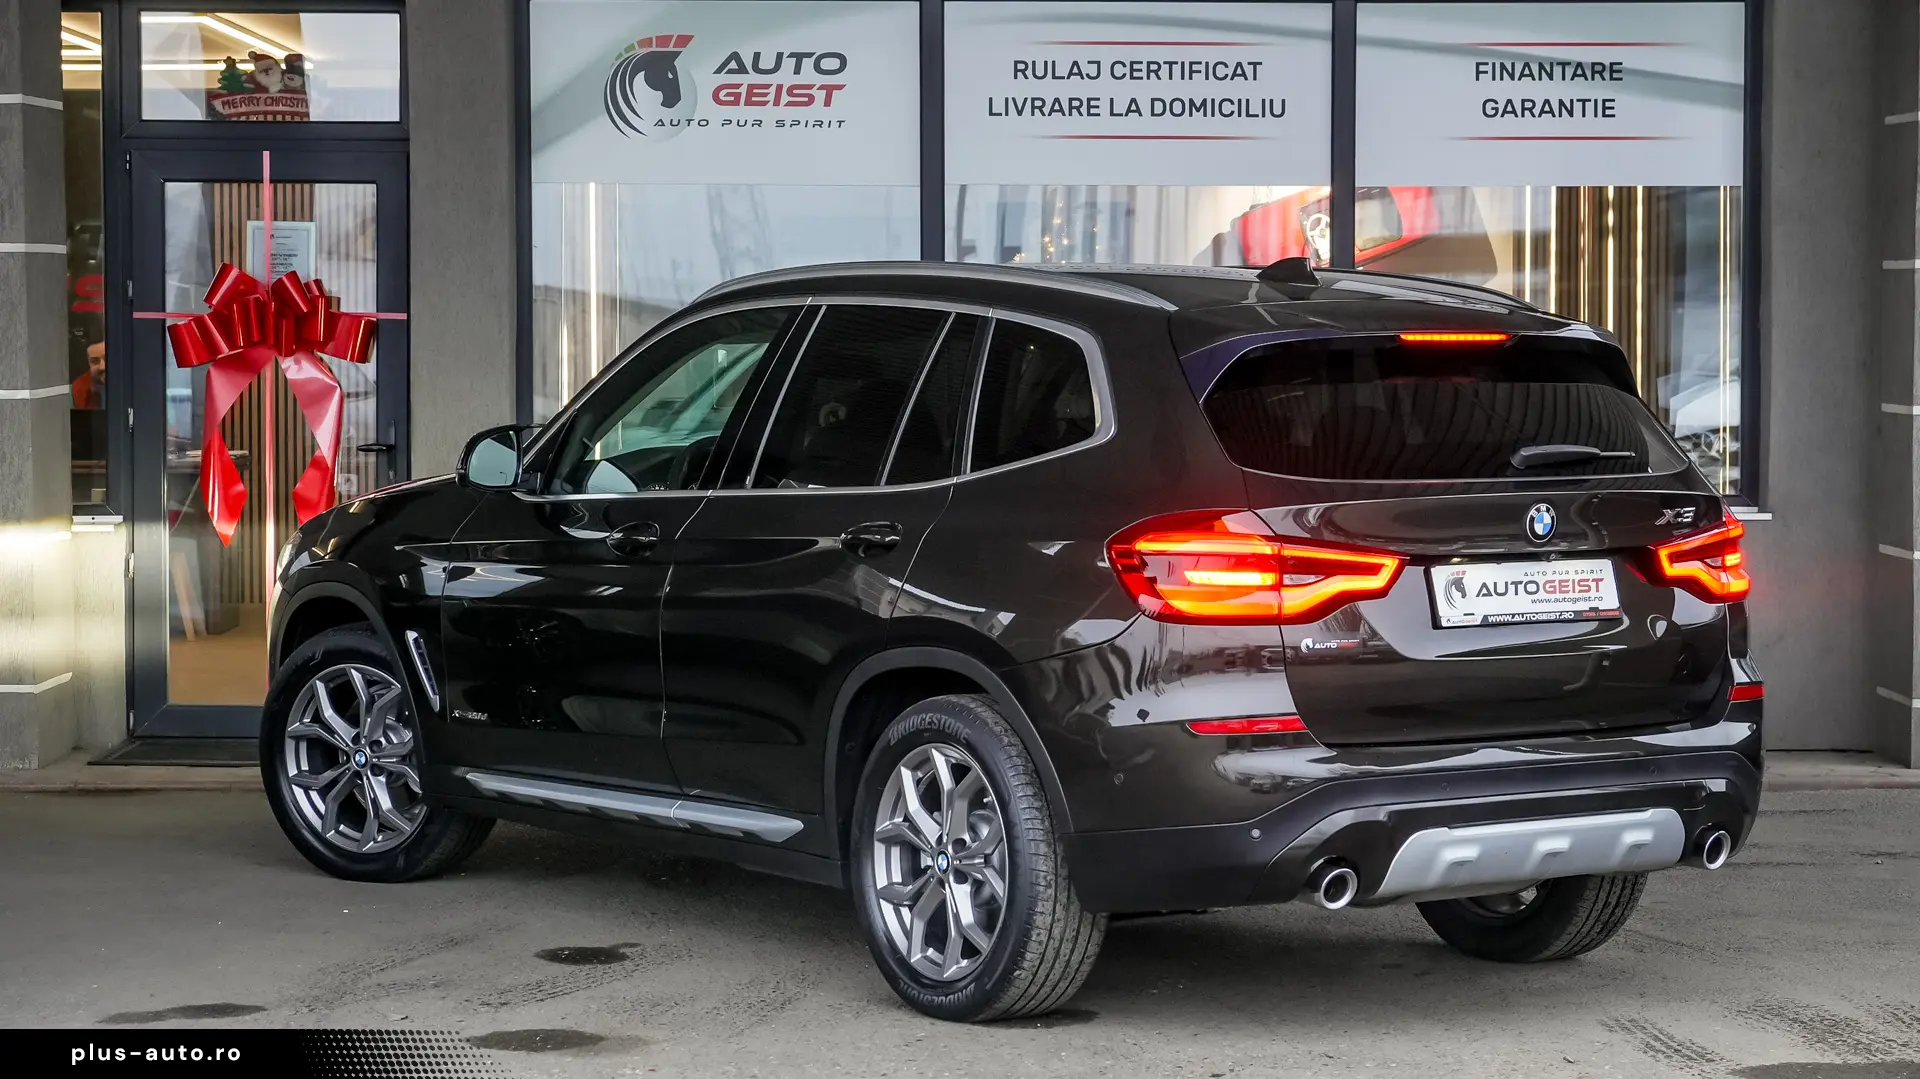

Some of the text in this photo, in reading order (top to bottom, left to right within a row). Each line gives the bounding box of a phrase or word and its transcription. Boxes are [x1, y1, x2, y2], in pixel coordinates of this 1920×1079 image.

[712, 51, 848, 75] AUTO
[1013, 60, 1263, 81] RULAJ CERTIFICAT
[1474, 61, 1624, 82] FINANTARE
[222, 96, 261, 110] MERRY
[711, 82, 848, 108] GEIST
[988, 97, 1287, 118] LIVRARE LA DOMICILIU
[1481, 98, 1616, 118] GARANTIE
[653, 118, 847, 129] AUTO PUR SPIRIT
[1654, 506, 1696, 526] X3
[1475, 577, 1604, 598] AUTOGEIST
[1531, 595, 1603, 605] www.autogeist.ro
[1487, 611, 1575, 623] WWW.AUTOGEIST.RO
[888, 712, 971, 746] BRIDGESTONE
